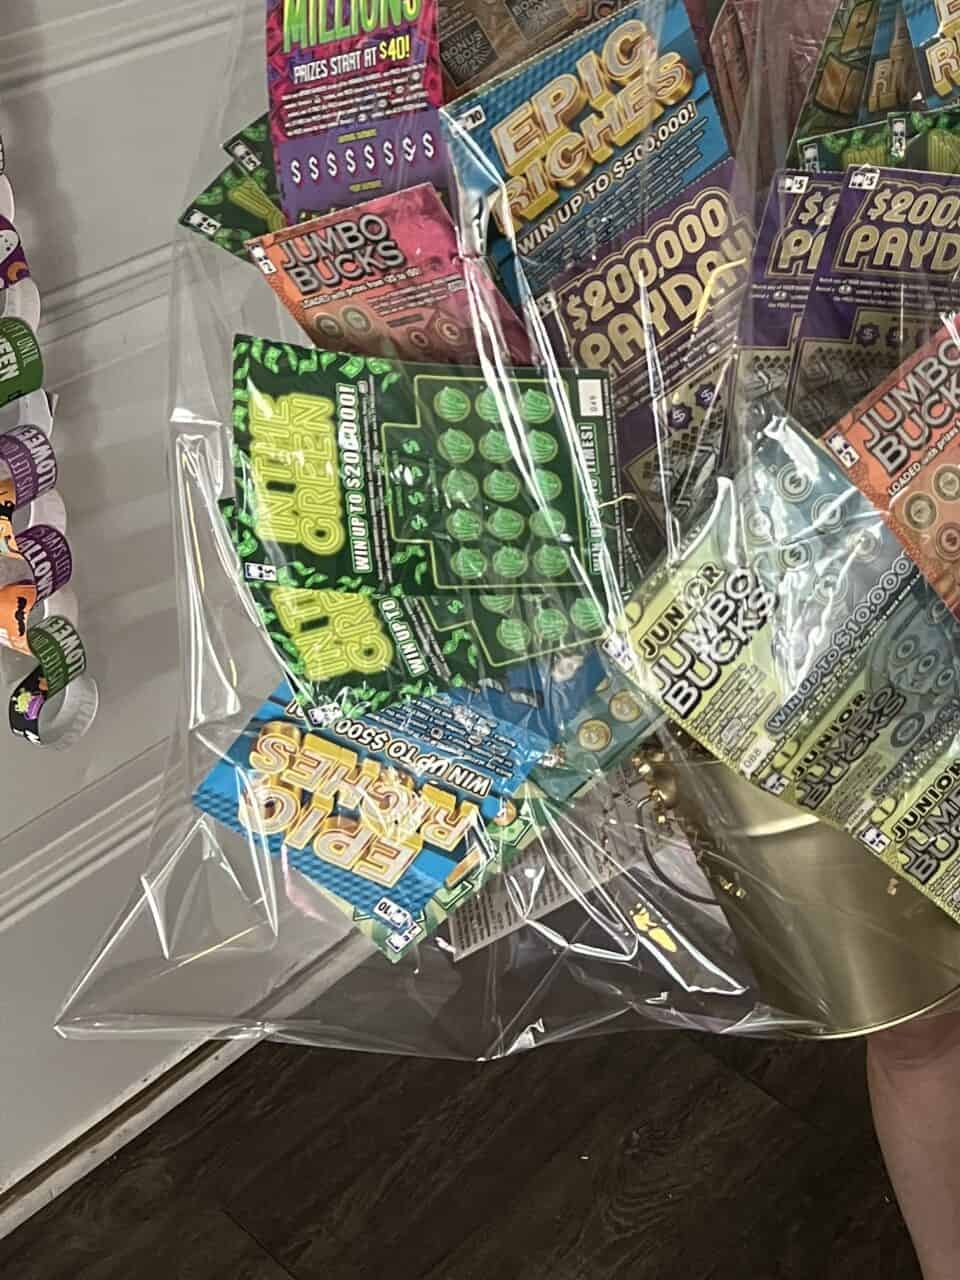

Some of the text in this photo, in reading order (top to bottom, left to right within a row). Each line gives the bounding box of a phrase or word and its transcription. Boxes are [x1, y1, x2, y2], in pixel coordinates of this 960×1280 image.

[293, 33, 411, 85] PRIZES START AT $40!
[441, 30, 482, 64] BONUS
[491, 20, 656, 177] EPIC
[489, 52, 692, 240] RICHES
[518, 100, 697, 255] WIN UP TO $500,000!
[278, 214, 389, 268] JUMBO
[288, 240, 405, 294] BUCKS
[566, 197, 729, 332] $200,000
[578, 229, 748, 369] PAYDAY
[251, 394, 294, 482] THE
[293, 394, 345, 554] GREEN
[348, 494, 363, 514] TO
[889, 462, 921, 496] LOADED
[350, 517, 367, 537] UP
[353, 539, 370, 571] WIN
[382, 599, 426, 675] WIN UP TO
[651, 569, 752, 692] JUMBO
[664, 588, 776, 717] BUCKS
[767, 554, 913, 730] WIN UP TO $10,000
[387, 741, 418, 765] TO
[414, 752, 446, 776] UP
[793, 693, 866, 778] JUNIOR
[447, 767, 493, 798] WIN
[238, 774, 423, 888] EPIC
